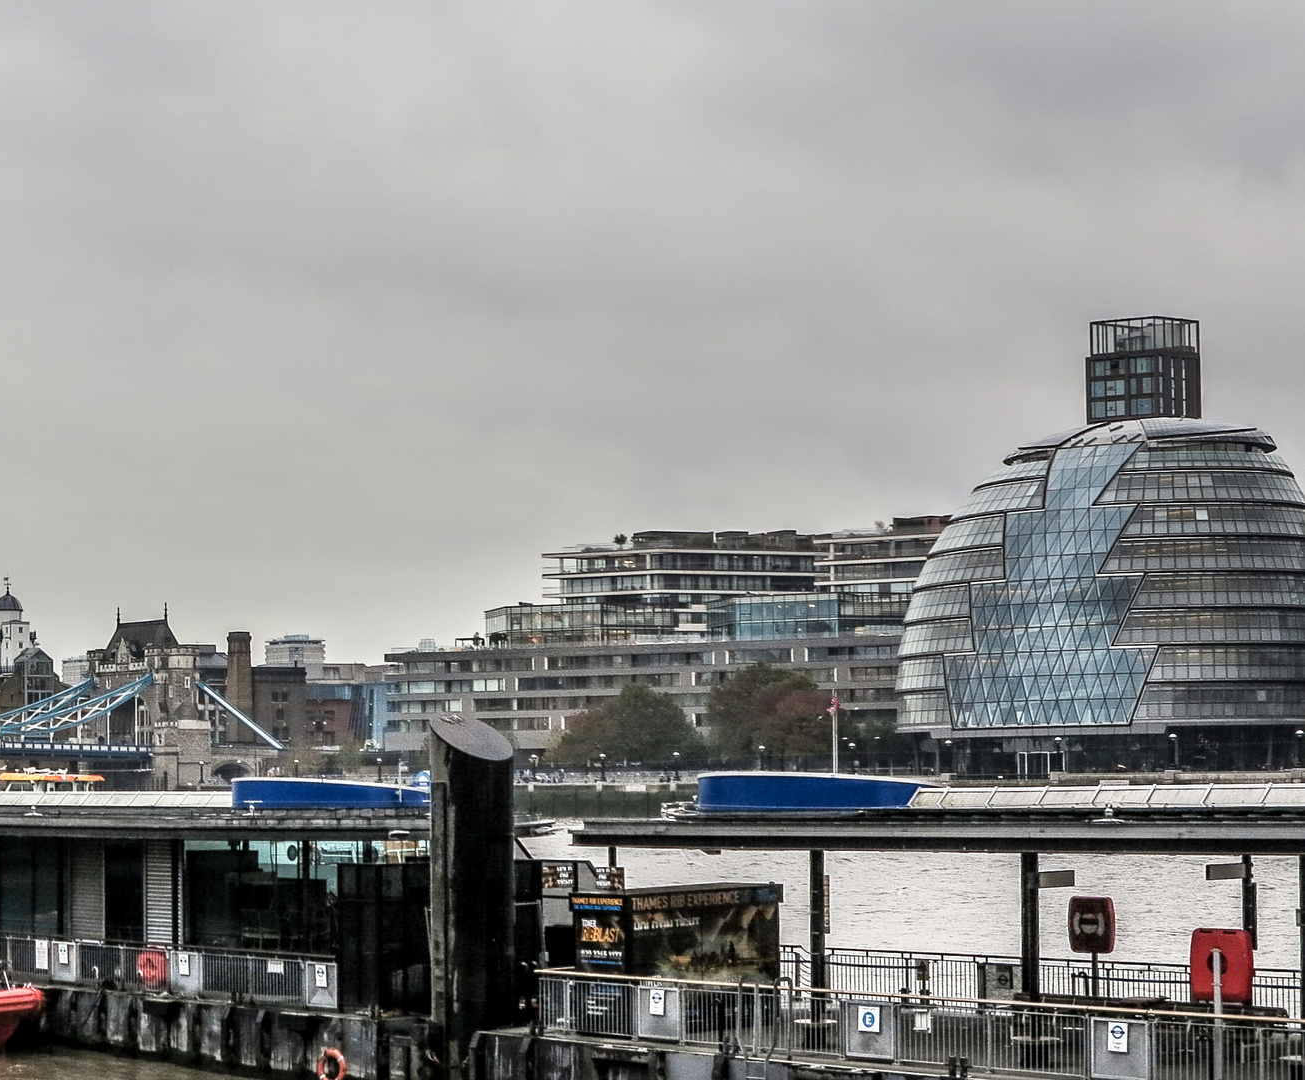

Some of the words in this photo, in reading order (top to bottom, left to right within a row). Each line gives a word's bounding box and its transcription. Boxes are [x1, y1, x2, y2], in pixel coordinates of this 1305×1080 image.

[631, 894, 668, 911] THAMES
[670, 893, 685, 909] RIB
[687, 889, 740, 907] EXPERIENCE
